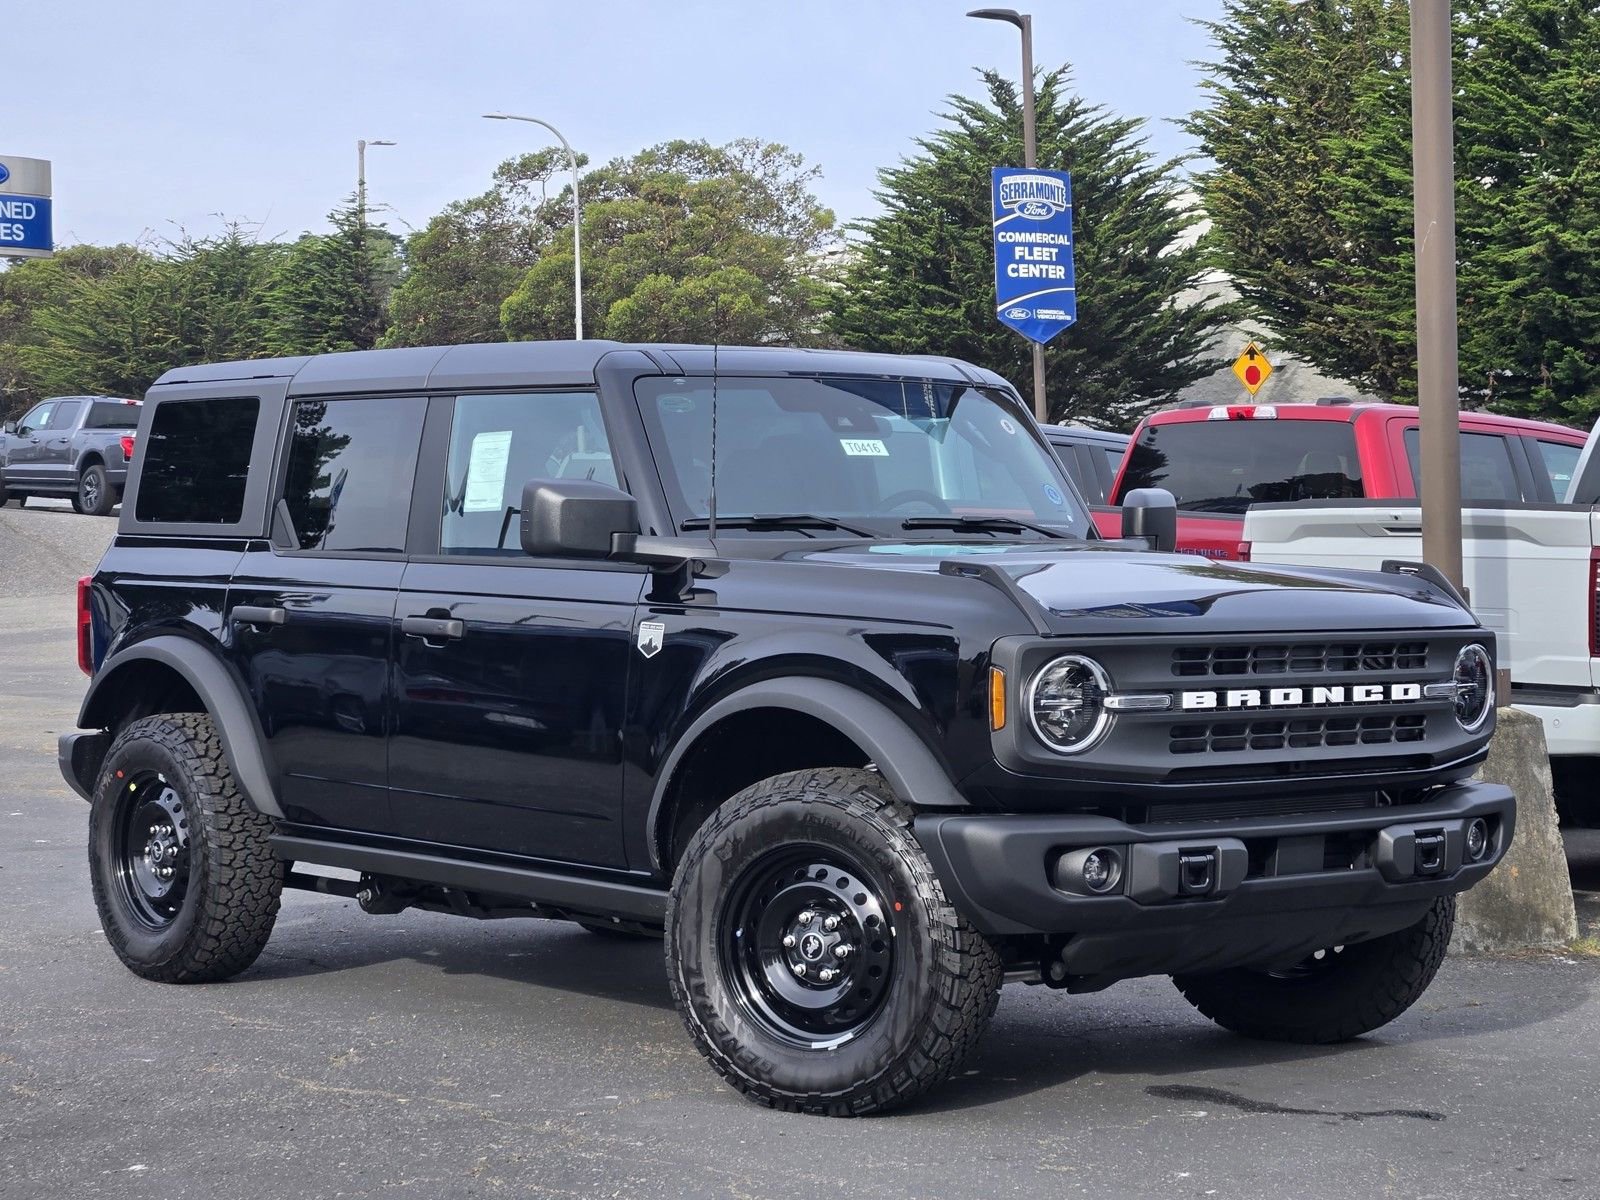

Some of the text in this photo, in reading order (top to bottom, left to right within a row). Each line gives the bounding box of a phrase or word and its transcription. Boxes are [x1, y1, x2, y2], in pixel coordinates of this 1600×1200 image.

[1001, 181, 1065, 204] SERRAMONTE
[1023, 202, 1048, 216] Ford
[998, 232, 1071, 245] COMMERCIAL
[1014, 247, 1059, 261] FLEET
[1007, 264, 1065, 279] CENTER
[845, 442, 881, 453] T0416
[1182, 684, 1421, 709] BRONCO
